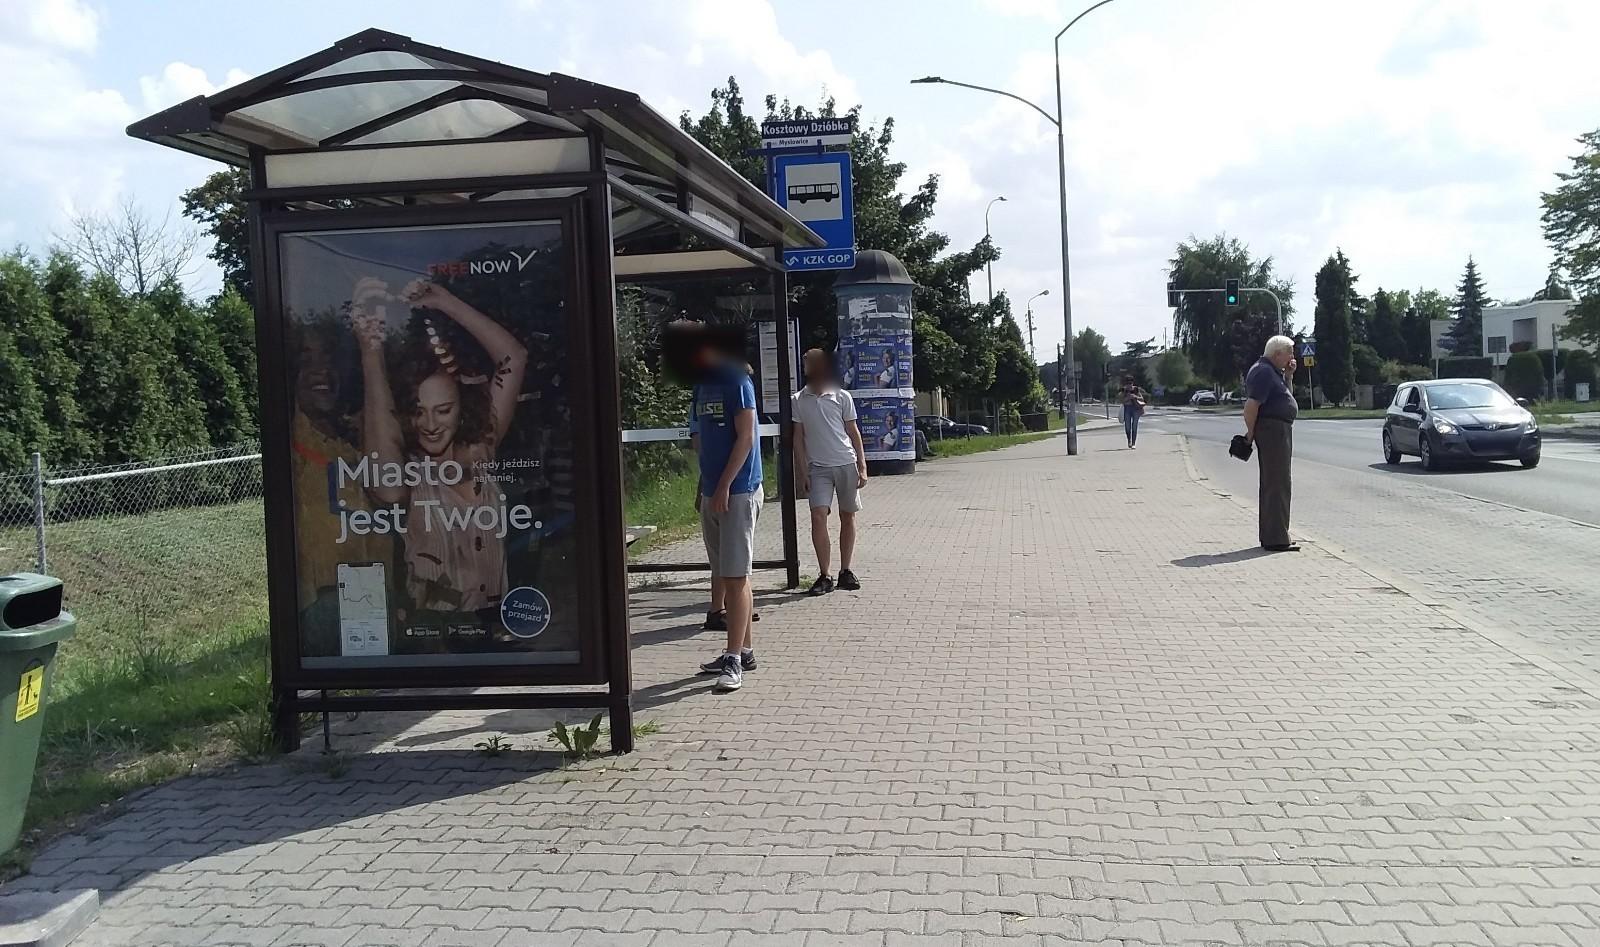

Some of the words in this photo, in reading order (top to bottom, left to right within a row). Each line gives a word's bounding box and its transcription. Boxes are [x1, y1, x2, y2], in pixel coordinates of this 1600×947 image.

[763, 124, 809, 135] Kosztowy
[811, 121, 849, 132] Dzióbka
[803, 255, 825, 264] KZK
[827, 254, 850, 263] GOP
[337, 451, 463, 489] Miasto
[472, 459, 500, 470] Kiedy
[501, 458, 541, 470] jeździsz
[473, 472, 517, 484] najtaniej.
[335, 499, 408, 544] jest
[414, 493, 543, 539] Twoje.
[512, 600, 543, 612] Zamów
[508, 610, 542, 622] przejazd
